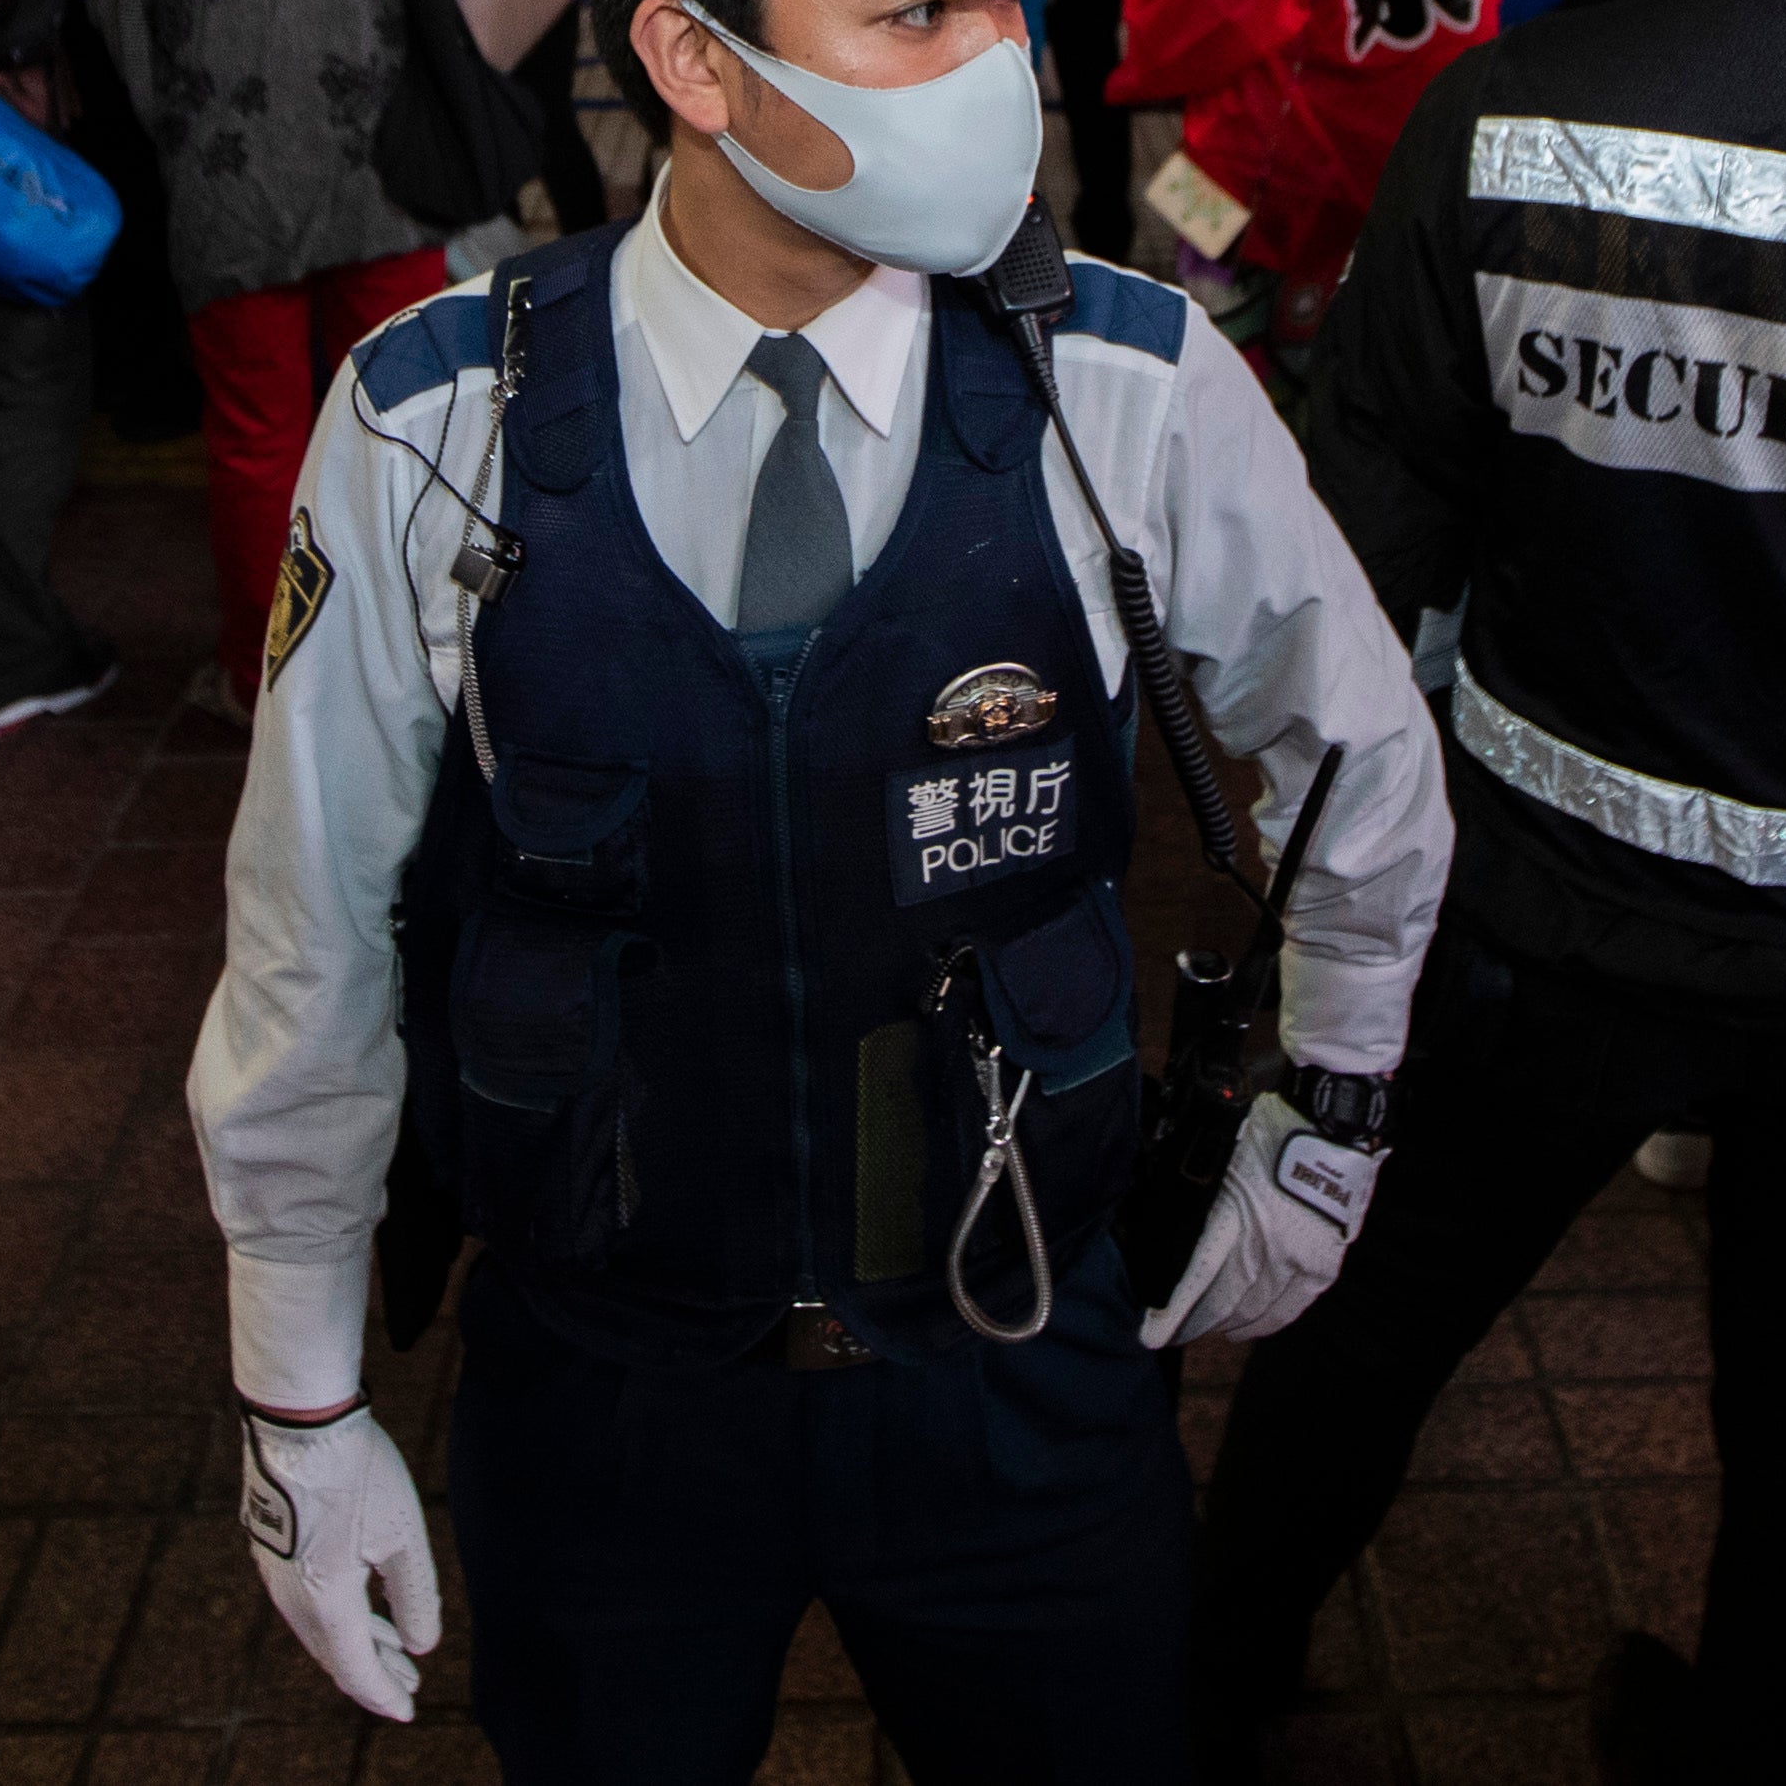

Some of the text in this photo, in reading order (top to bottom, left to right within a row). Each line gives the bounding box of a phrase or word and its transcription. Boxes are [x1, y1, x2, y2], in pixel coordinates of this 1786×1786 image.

[907, 760, 1071, 840] 警視庁
[921, 819, 1060, 884] POLICE
